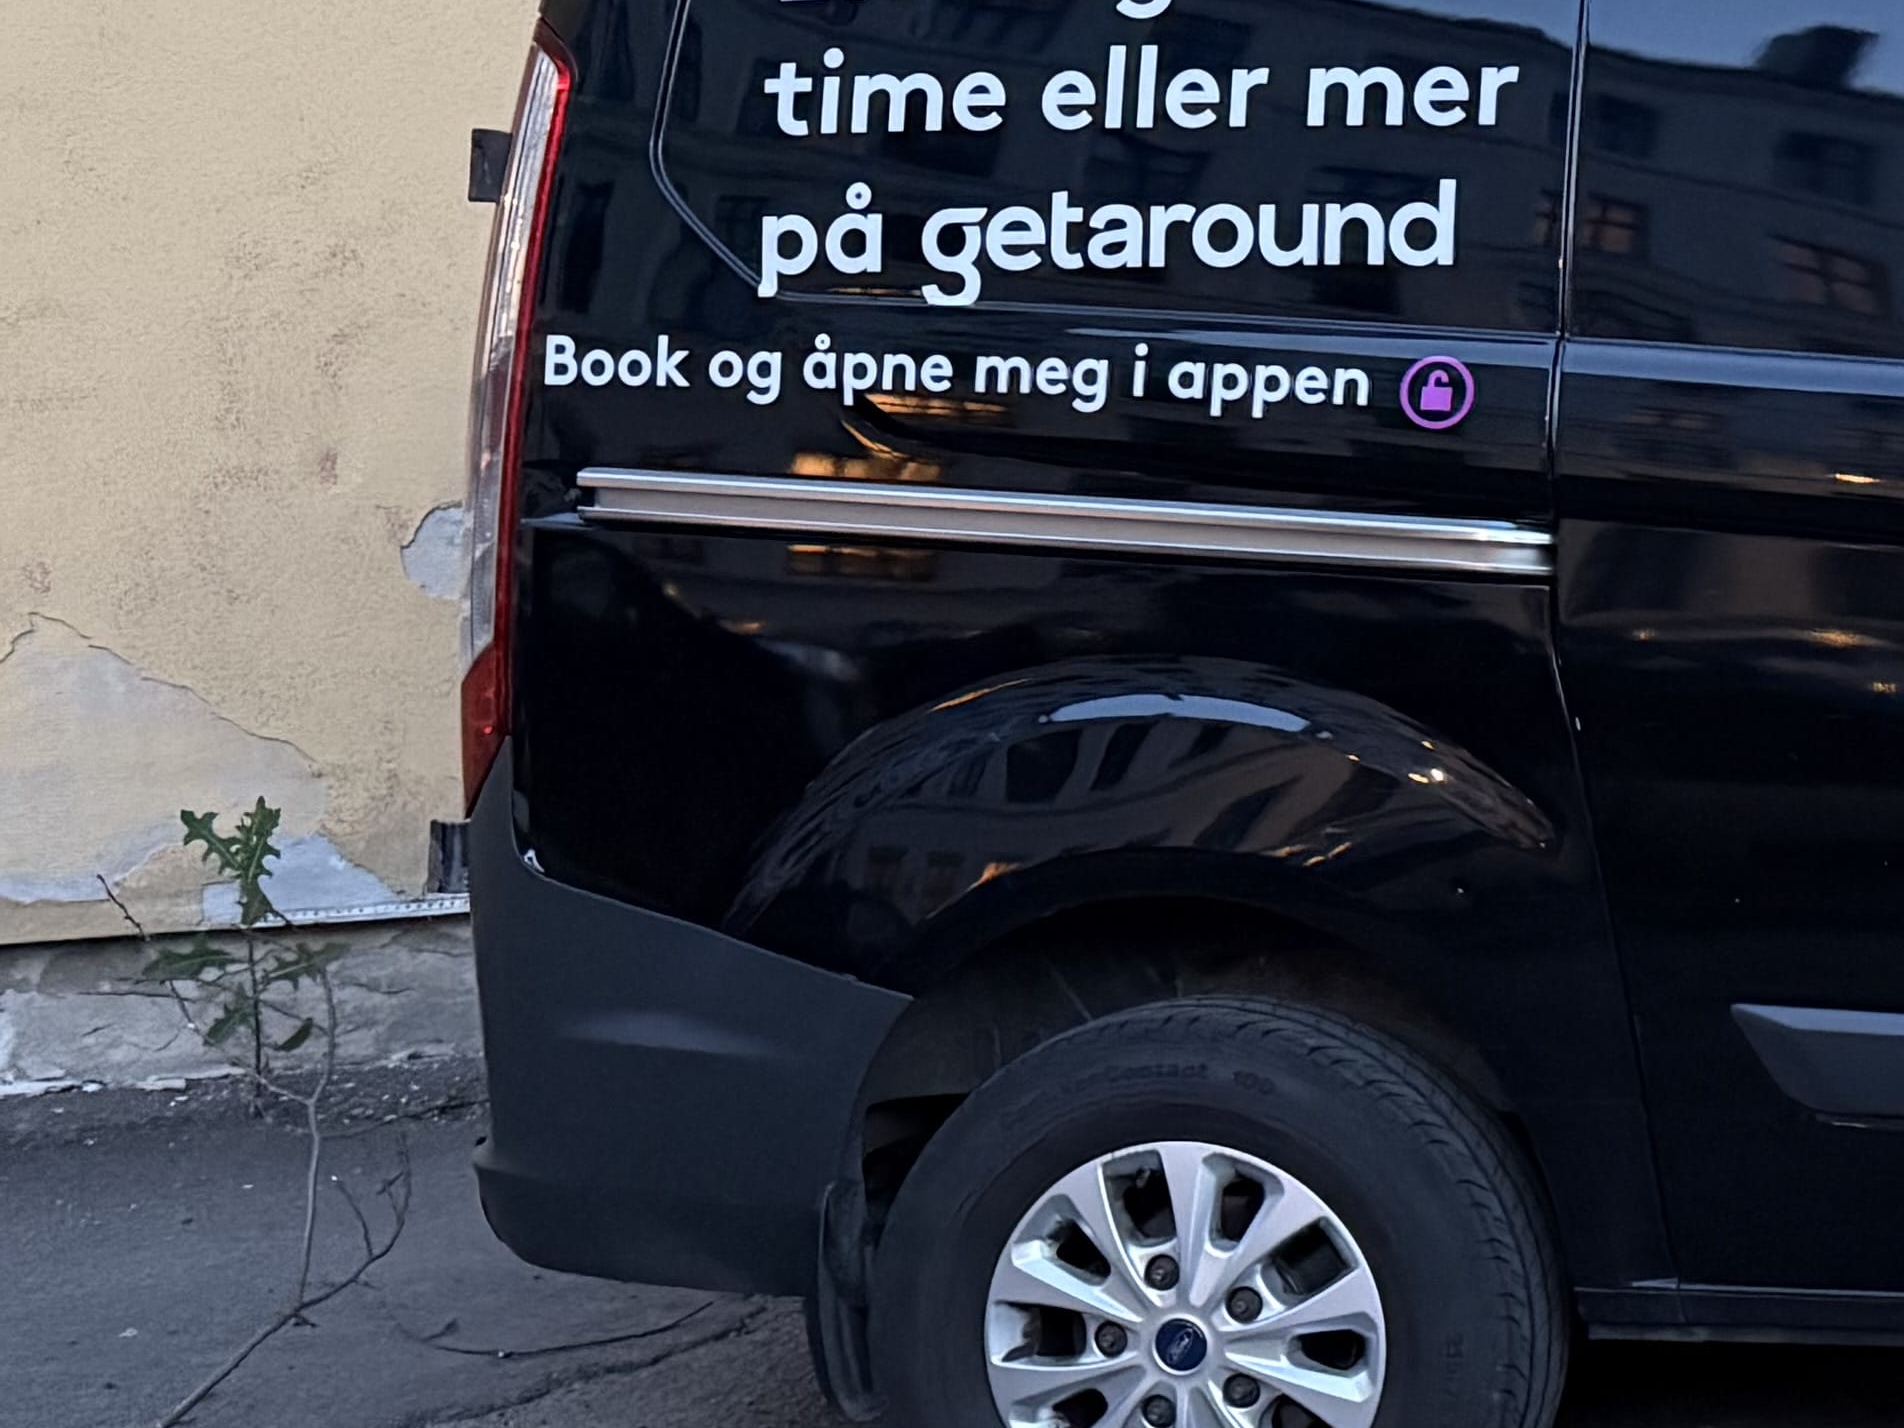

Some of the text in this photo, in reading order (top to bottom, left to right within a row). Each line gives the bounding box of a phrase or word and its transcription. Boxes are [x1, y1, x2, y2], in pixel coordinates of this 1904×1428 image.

[763, 43, 1521, 137] time eller mer
[756, 177, 1458, 307] på getaround
[543, 332, 1370, 419] Book og åpne meg i appen
